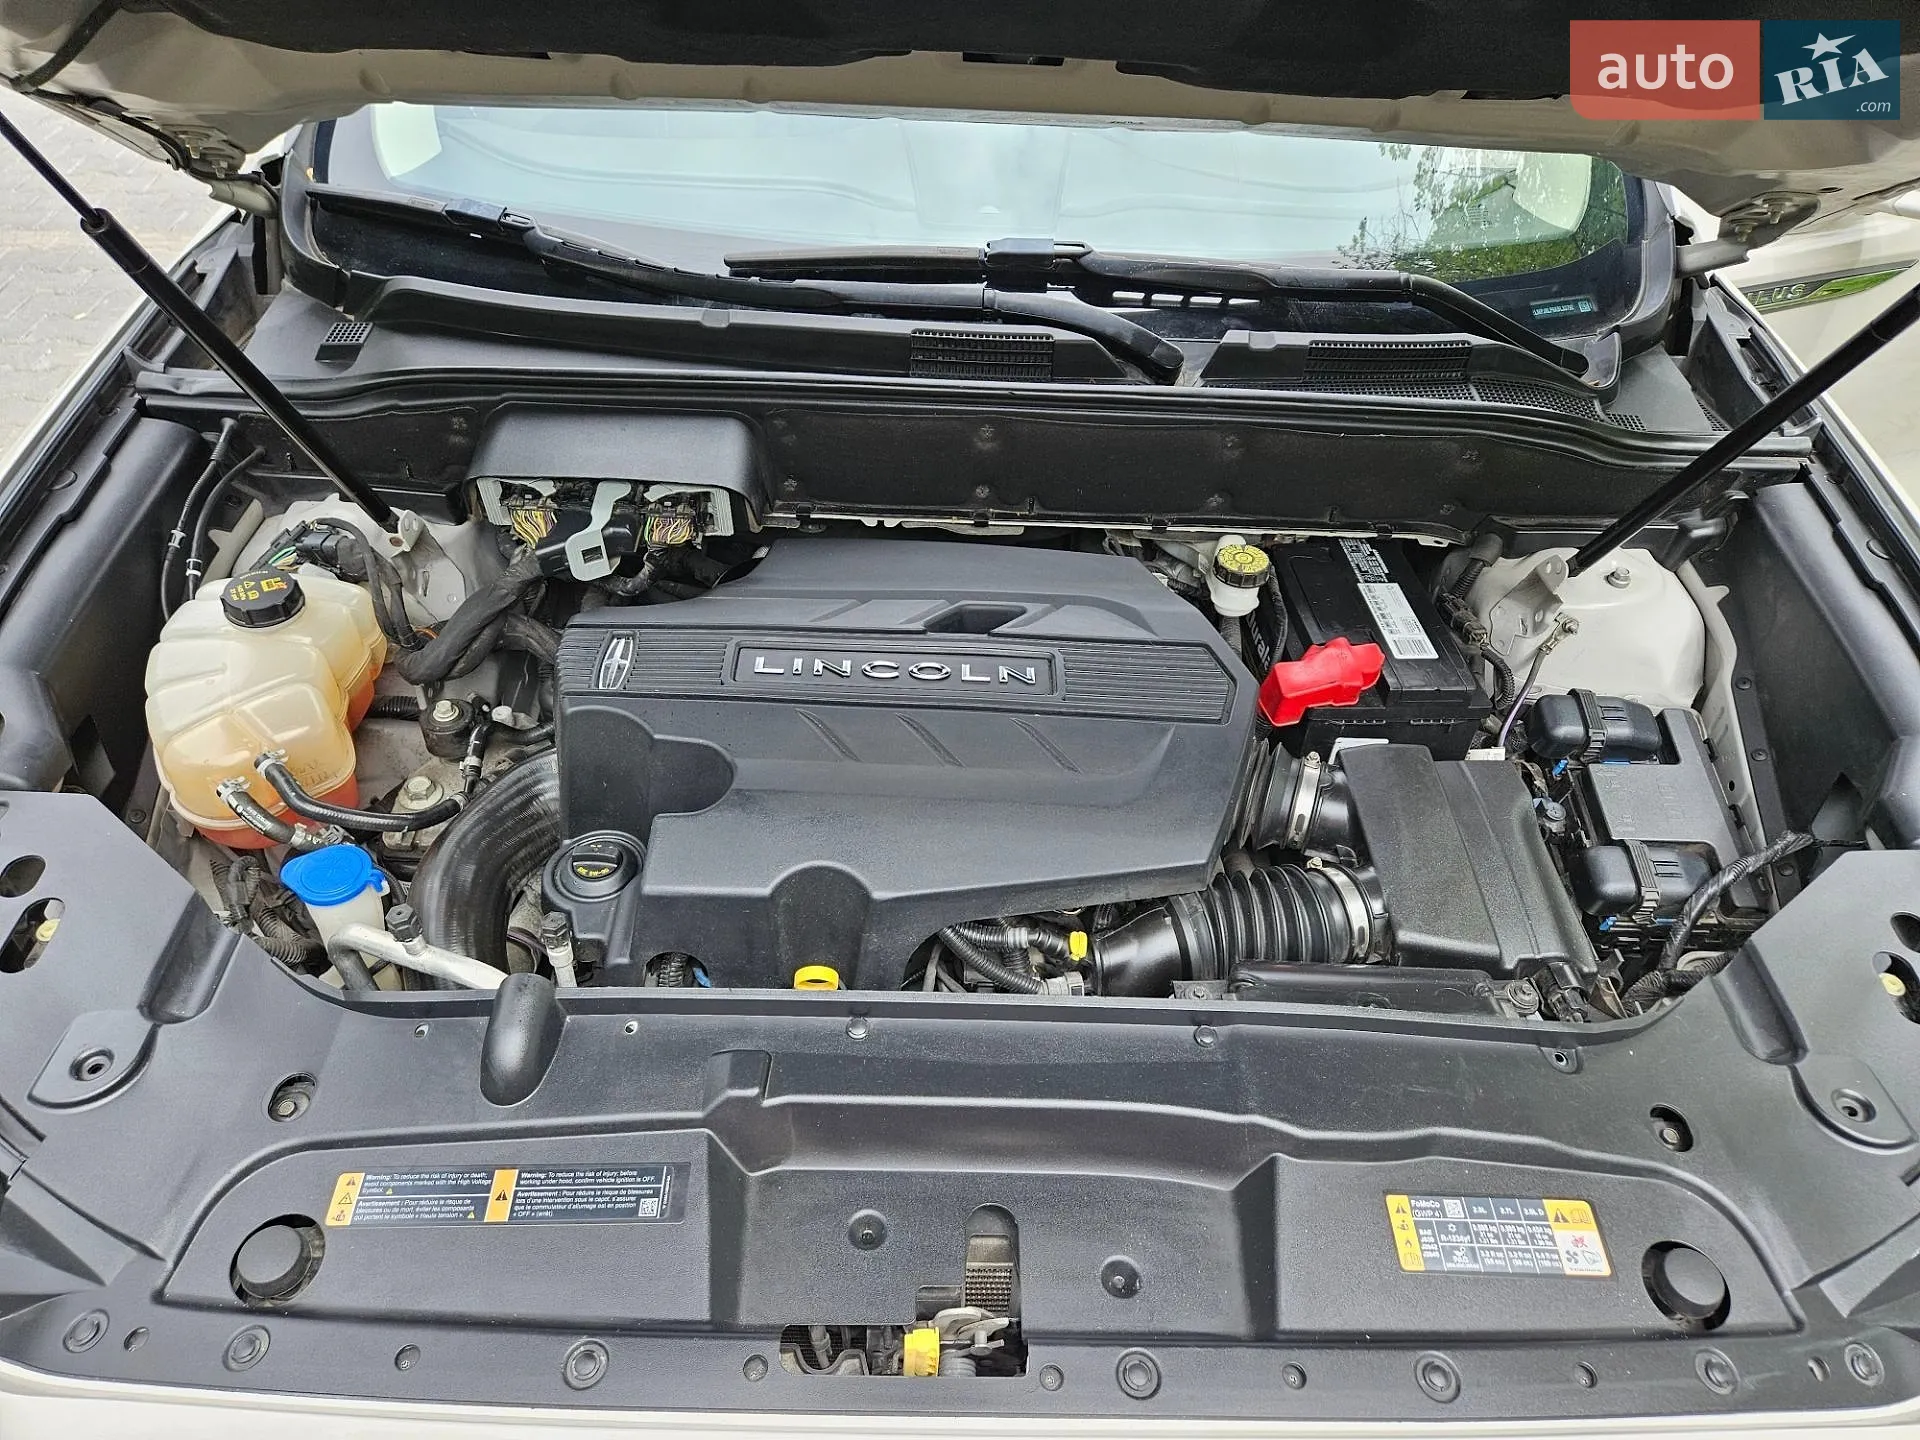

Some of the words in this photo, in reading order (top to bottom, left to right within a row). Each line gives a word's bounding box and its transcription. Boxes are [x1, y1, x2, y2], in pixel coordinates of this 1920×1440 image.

[753, 655, 1037, 686] LINCOLN
[366, 1174, 391, 1182] Warning:
[449, 1173, 462, 1181] injury
[471, 1178, 492, 1186] Voltage
[520, 1178, 541, 1186] working
[616, 1176, 636, 1184] ignition
[602, 1189, 619, 1197] risque
[532, 1203, 567, 1211] commutateur
[567, 1203, 597, 1211] d'allumage
[614, 1202, 637, 1210] position
[1410, 1199, 1441, 1208] FoMoCo
[364, 1213, 384, 1221] portent
[391, 1213, 414, 1221] symbole
[1440, 1234, 1471, 1243] R-1234yf
